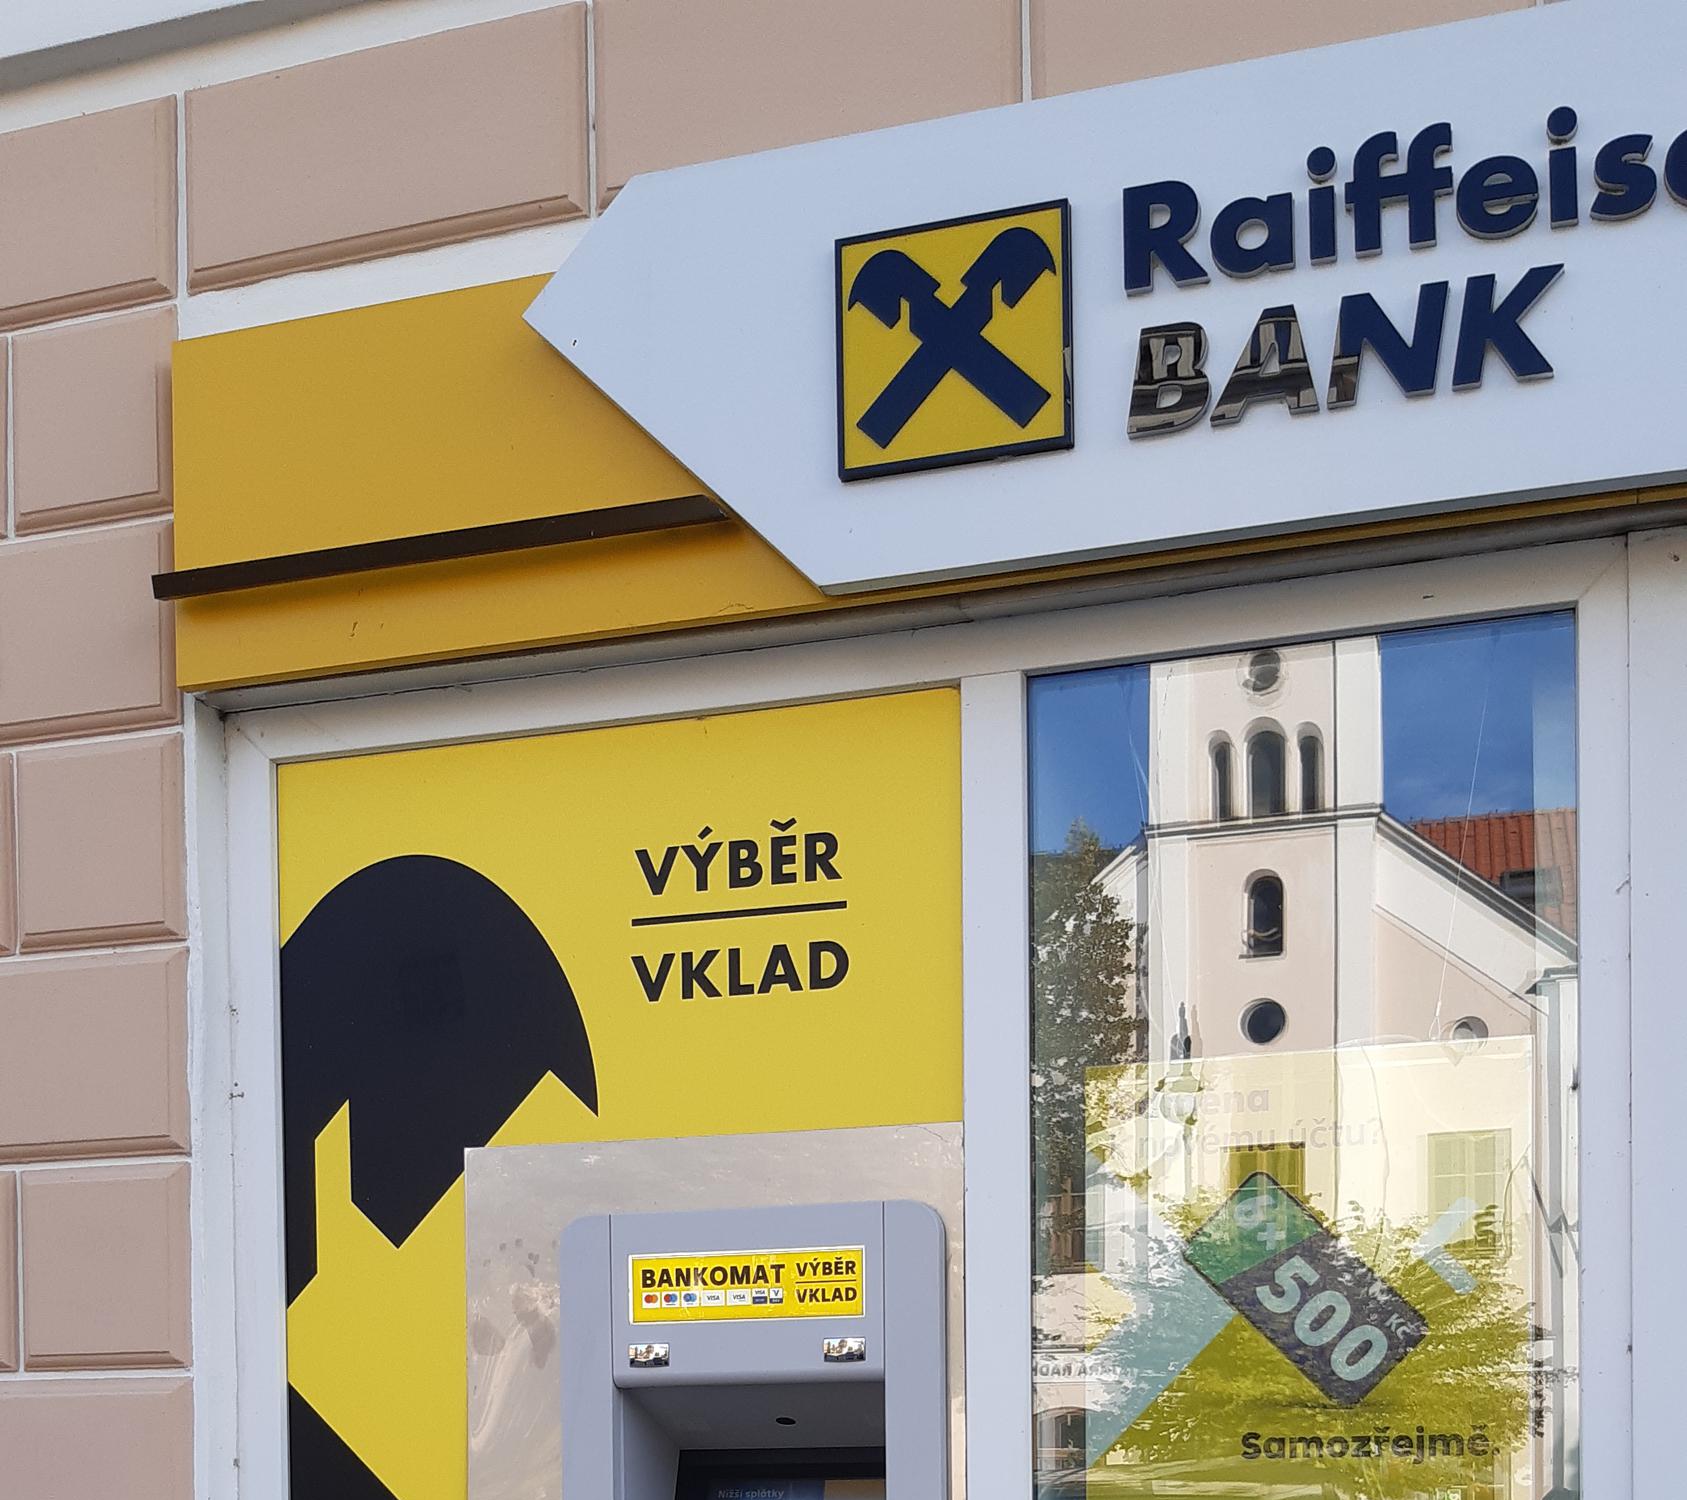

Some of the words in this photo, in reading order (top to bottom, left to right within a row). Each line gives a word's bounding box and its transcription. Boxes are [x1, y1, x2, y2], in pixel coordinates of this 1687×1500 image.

[1126, 262, 1566, 440] BANK
[634, 817, 843, 896] VÝBĚR
[631, 940, 850, 1002] VKLAD
[640, 1263, 786, 1289] BANKOMAT
[795, 1257, 857, 1278] VÝBĚR
[796, 1286, 858, 1304] VKLAD
[1255, 1254, 1389, 1381] 500
[1241, 1425, 1501, 1465] Samozřejmě.
